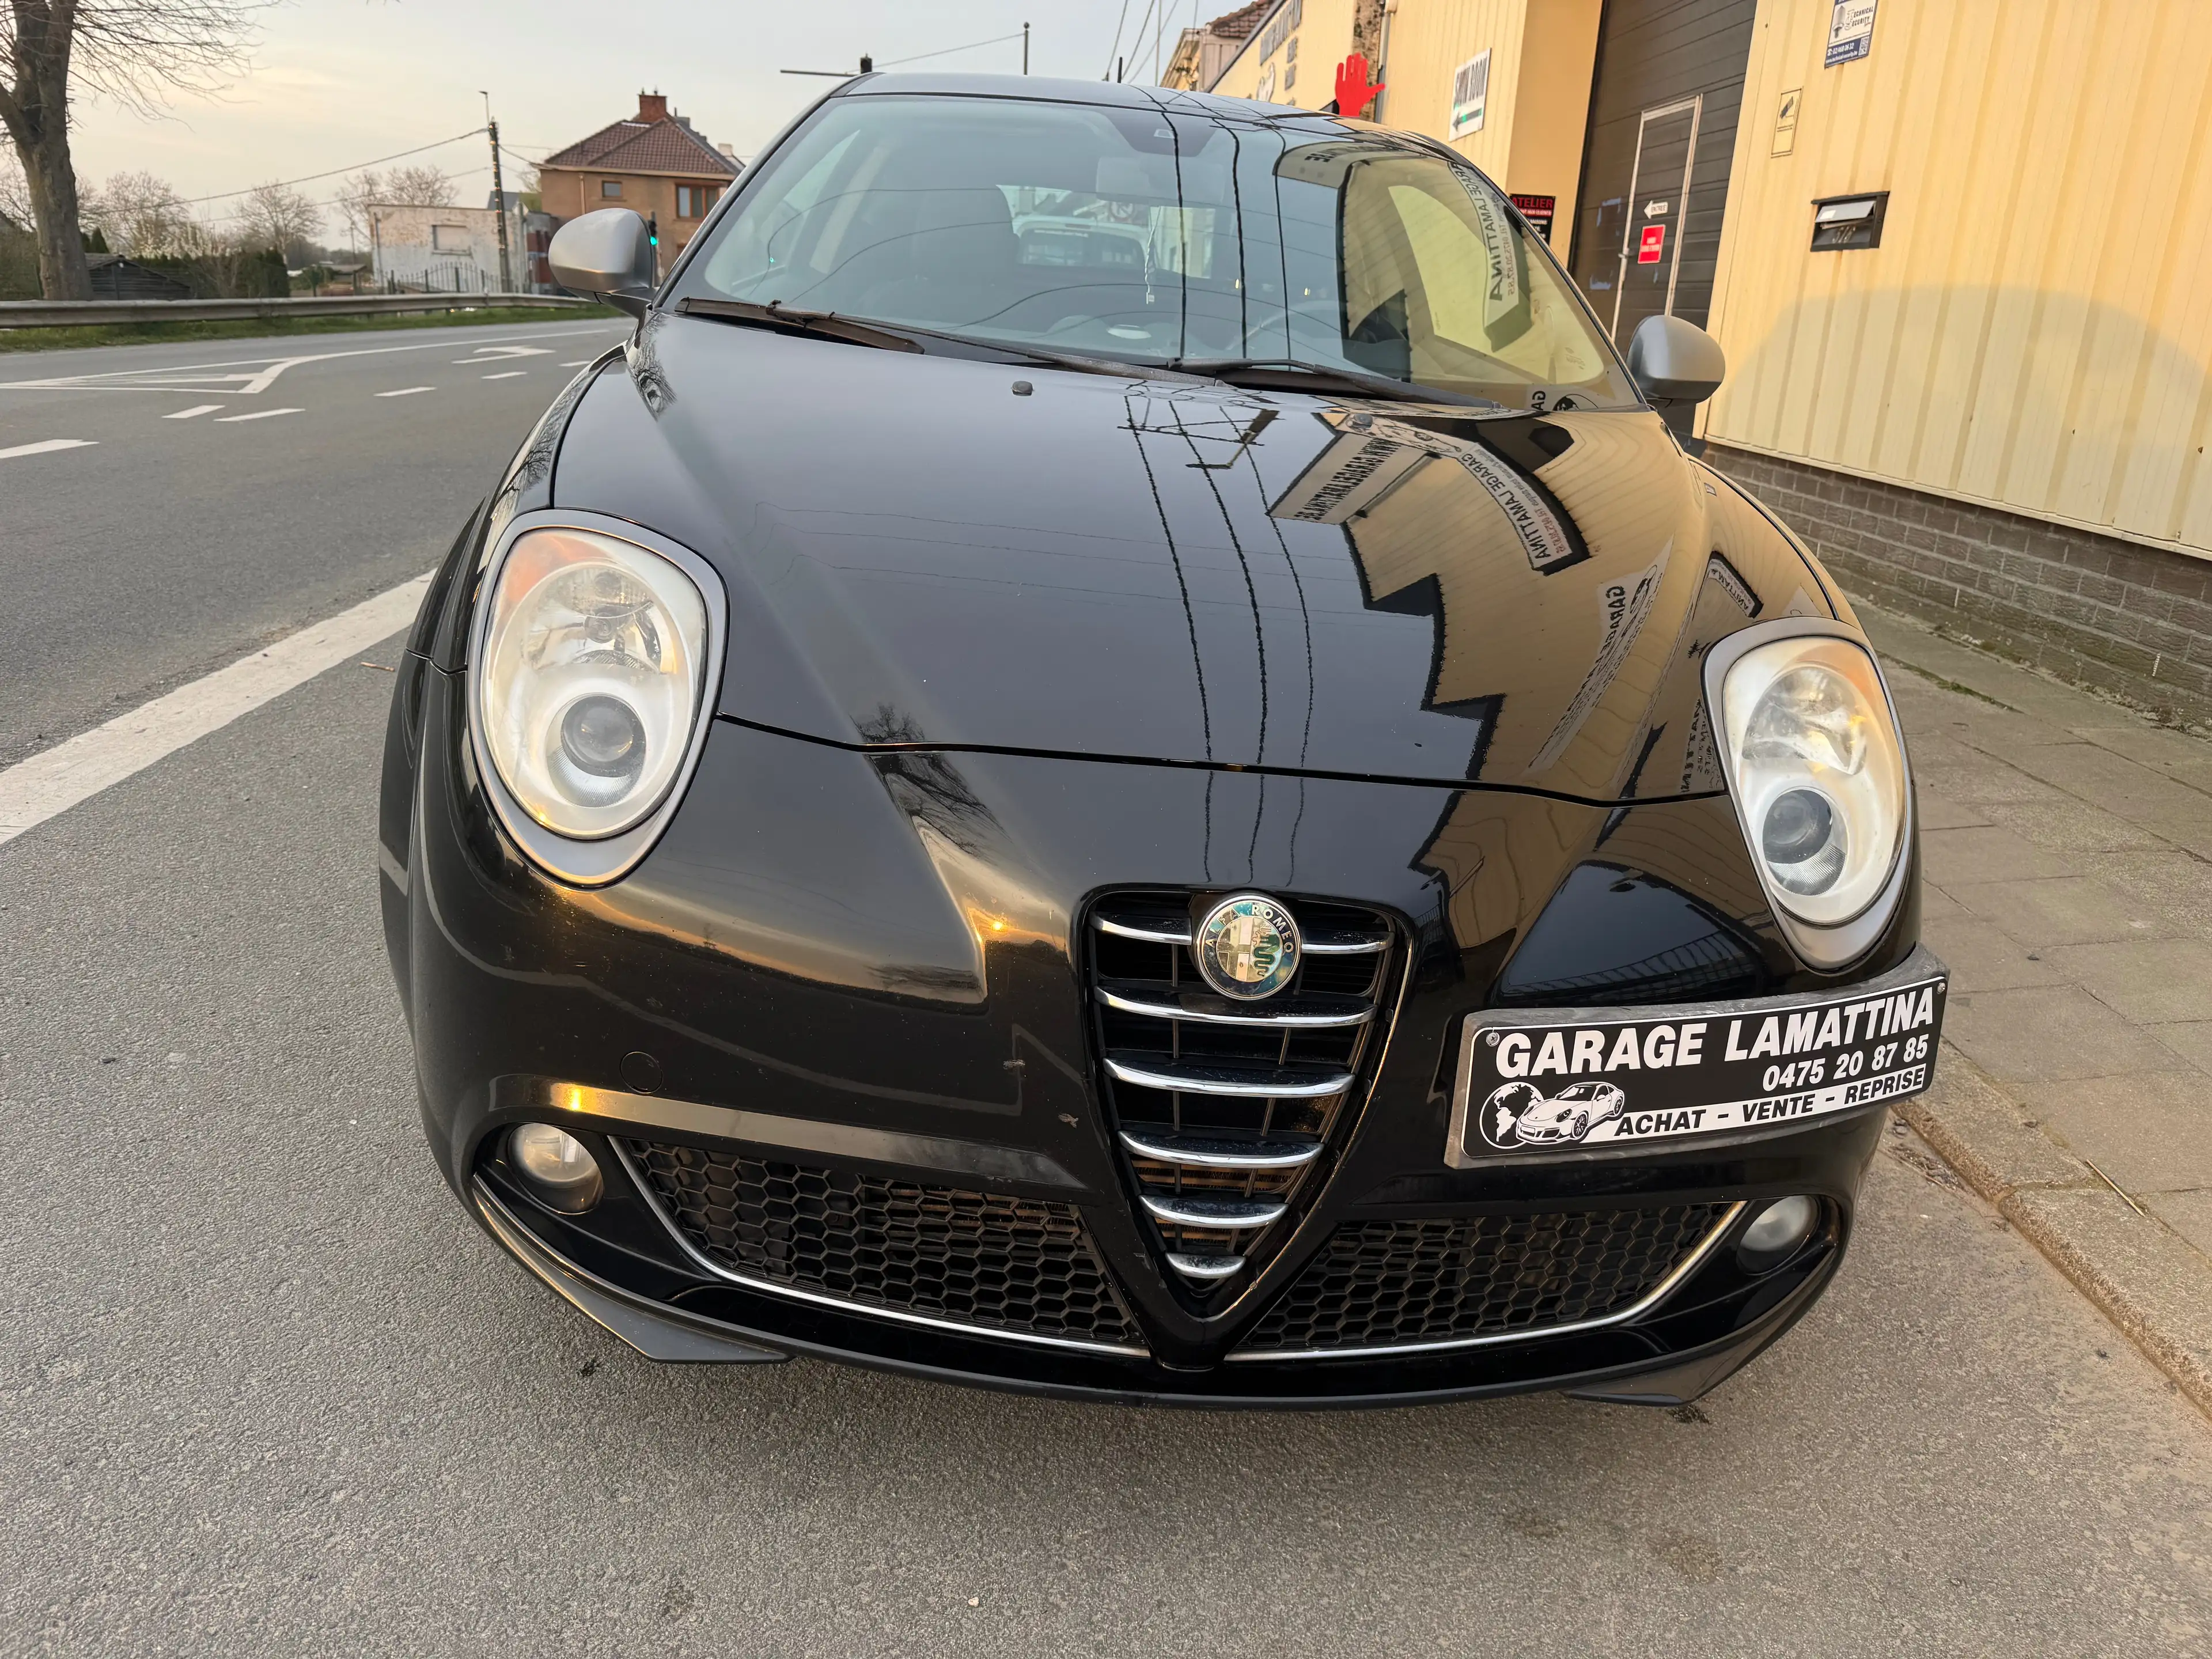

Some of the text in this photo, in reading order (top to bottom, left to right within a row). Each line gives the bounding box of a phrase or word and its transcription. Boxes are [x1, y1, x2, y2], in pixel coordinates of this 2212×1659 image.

[1512, 197, 1553, 209] ATELIER
[1205, 904, 1294, 953] ALFA ROMEO
[1496, 987, 1933, 1078] GARAGE LAMATTINA
[1763, 1034, 1929, 1091] 0475 20 87 85
[1614, 1109, 1706, 1137] ACHAT
[1743, 1094, 1816, 1122] VENTE
[1844, 1067, 1926, 1105] REPRISE
